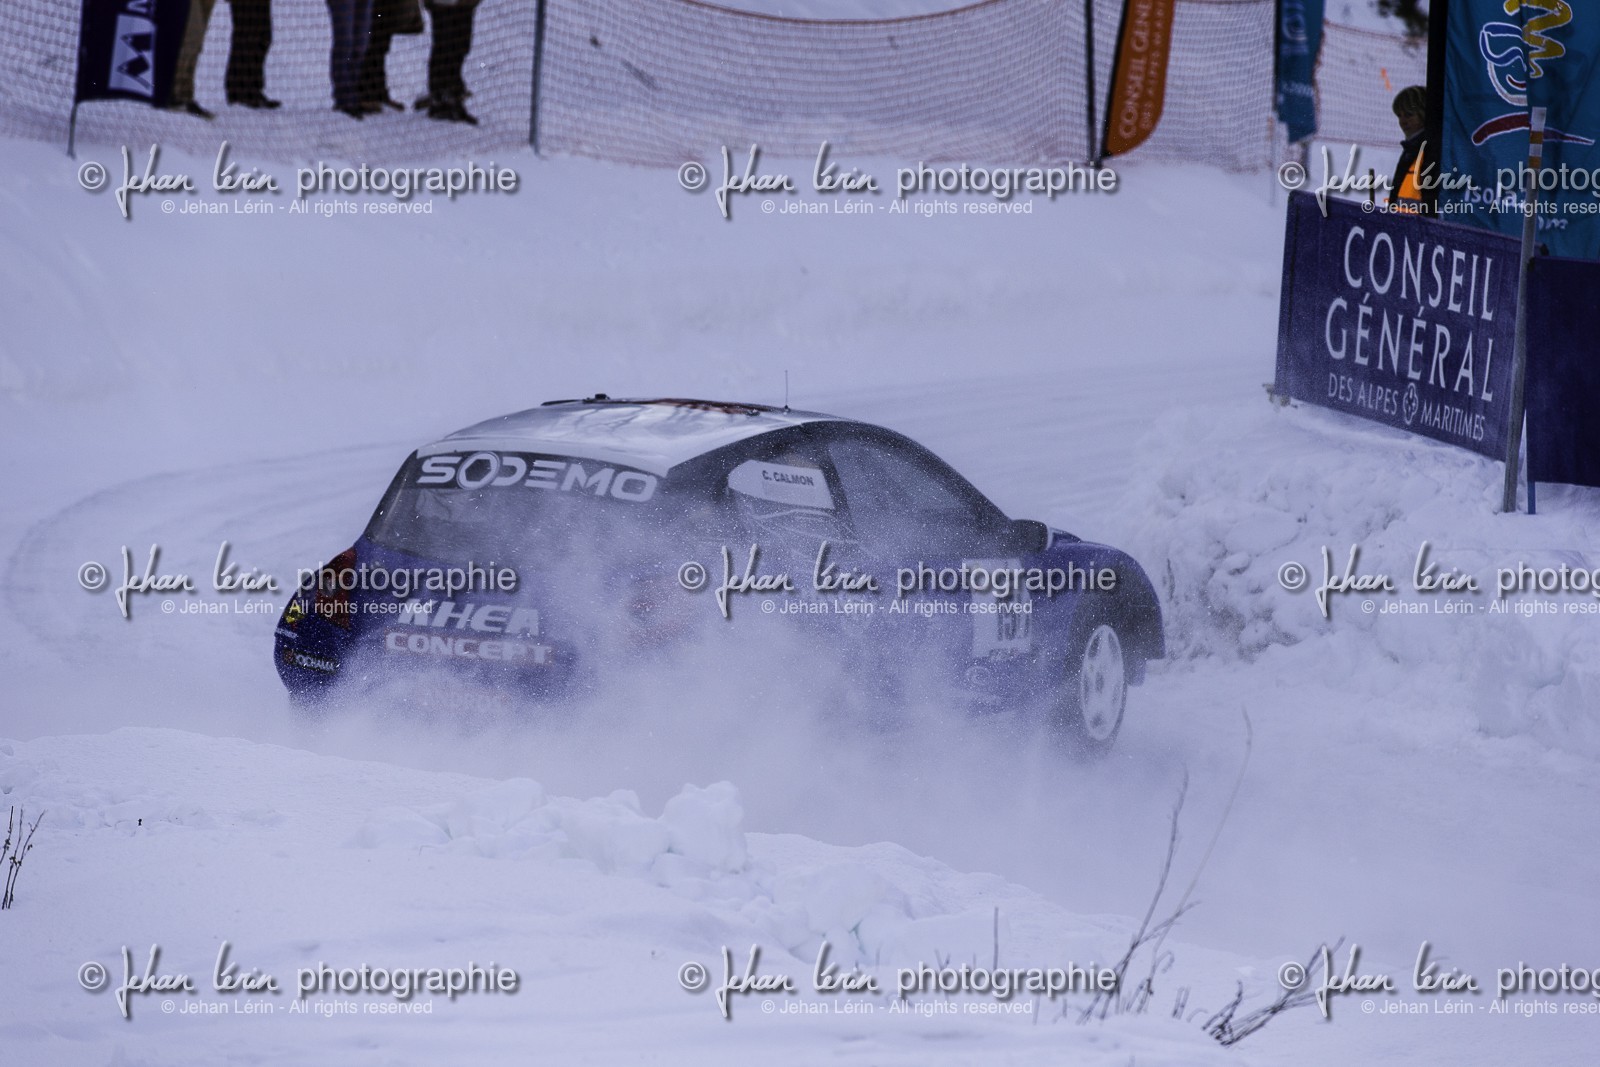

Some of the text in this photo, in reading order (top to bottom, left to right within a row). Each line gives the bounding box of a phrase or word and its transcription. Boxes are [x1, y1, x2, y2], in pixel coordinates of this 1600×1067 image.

[1344, 226, 1493, 321] CONSEIL
[1325, 293, 1493, 401] GÉNÉRAL
[1328, 373, 1486, 442] DES ALPES MARITIMES
[417, 452, 657, 502] SODEMO
[762, 470, 814, 486] C. CALMON
[385, 632, 552, 665] CONCEPT
